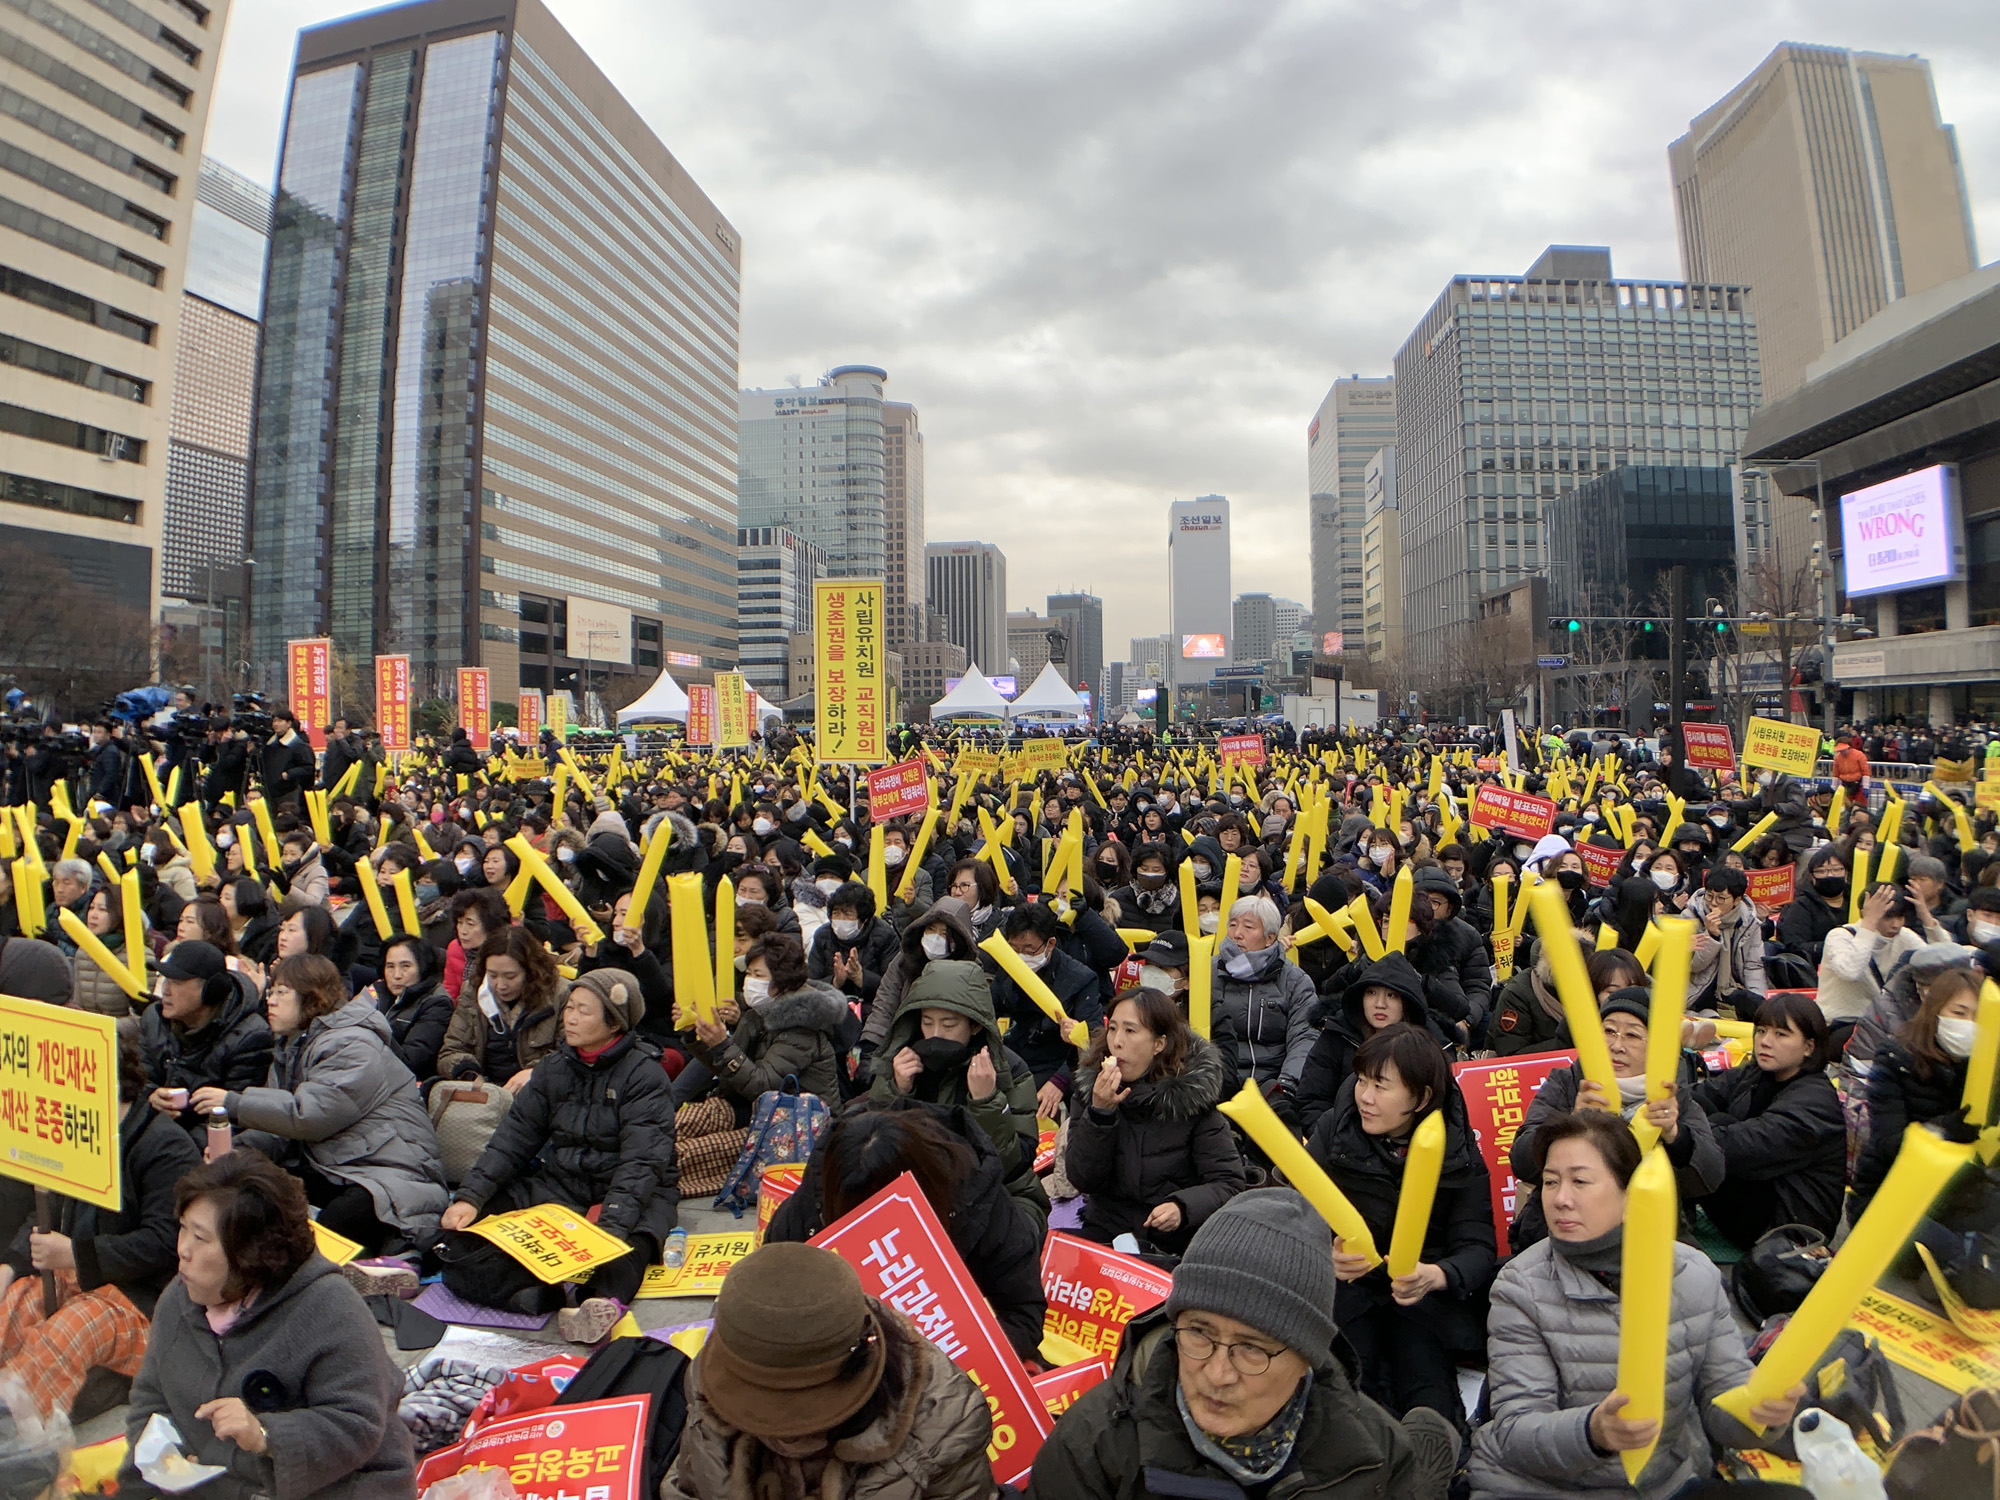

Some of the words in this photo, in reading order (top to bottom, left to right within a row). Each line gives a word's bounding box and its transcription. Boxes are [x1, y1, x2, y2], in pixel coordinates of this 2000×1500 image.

[774, 396, 818, 408] 동아일보
[1180, 515, 1222, 524] 조선일보
[1858, 509, 1925, 541] WRONG
[826, 592, 845, 661] 생존권을
[854, 591, 875, 678] 사립유치원
[295, 646, 308, 697] 학부모에게
[313, 646, 326, 696] 누리과정비
[382, 661, 393, 701] 사립3법
[394, 661, 406, 701] 당사자를
[720, 675, 730, 705] 사유재산
[732, 675, 741, 704] 설립자의
[313, 698, 325, 729] 지원은
[395, 704, 406, 744] 배제하는
[734, 706, 743, 735] 개인재산
[826, 668, 847, 754] 보장하라!
[855, 687, 875, 755] 교직원의
[1752, 726, 1786, 742] 사립유치원
[1786, 733, 1814, 749] 교직원의
[1752, 741, 1779, 757] 생존권을
[1780, 748, 1811, 764] 보장하라!
[872, 789, 900, 809] 학부모에게
[900, 782, 926, 801] 직접줘라!
[874, 772, 902, 793] 누리과정비
[902, 767, 920, 783] 지원은
[1477, 802, 1508, 820] 협박발언
[1509, 811, 1549, 830] 못참겠다!
[1480, 790, 1511, 807] 매일매일
[1513, 799, 1549, 816] 발표되는
[1581, 849, 1609, 865] 우리는
[1753, 871, 1790, 886] 중단하고
[0, 1030, 30, 1077] 자의
[36, 1038, 97, 1094] 개인재산
[0, 1087, 29, 1134] 재산
[35, 1094, 101, 1155] 존중하라!
[496, 1221, 563, 1268] 대책없는
[523, 1216, 594, 1262] 학부모도
[694, 1241, 750, 1259] 유치원
[860, 1227, 969, 1361] 누리과정비
[1044, 1271, 1136, 1325] 각성하라!
[1851, 1310, 1911, 1343] 유재산
[509, 1444, 626, 1485] 교육청은
